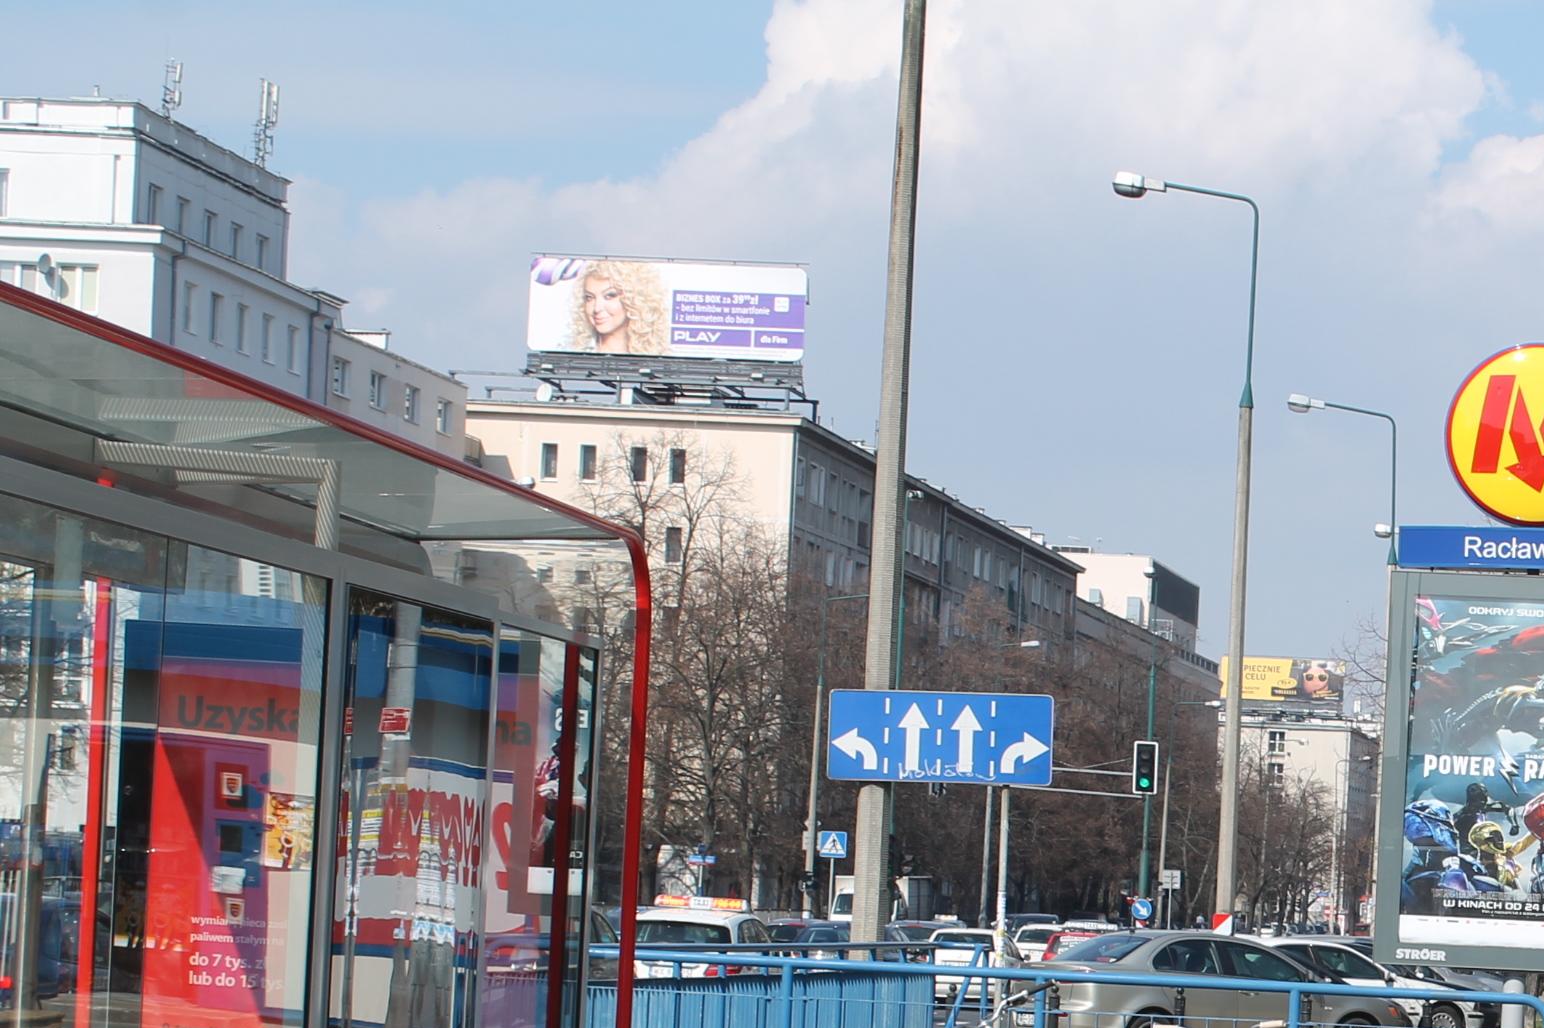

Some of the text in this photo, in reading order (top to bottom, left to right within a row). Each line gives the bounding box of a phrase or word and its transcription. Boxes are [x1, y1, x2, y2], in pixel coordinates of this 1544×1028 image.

[675, 293, 704, 303] BIZNES
[705, 294, 721, 304] BOX
[673, 330, 721, 343] PLAY
[1468, 606, 1514, 616] ODKRYJ
[1243, 664, 1281, 674] PIECZNIE
[1245, 673, 1266, 681] CELU
[1423, 753, 1495, 778] POWER
[1443, 899, 1456, 908] W
[1457, 900, 1502, 911] KINACH
[1504, 902, 1522, 911] OD
[1524, 902, 1540, 912] 24
[190, 932, 234, 944] paliwem
[189, 952, 209, 967] do
[212, 953, 222, 966] 7
[1395, 948, 1447, 962] STRÖER
[188, 970, 213, 985] lub
[215, 972, 236, 988] do
